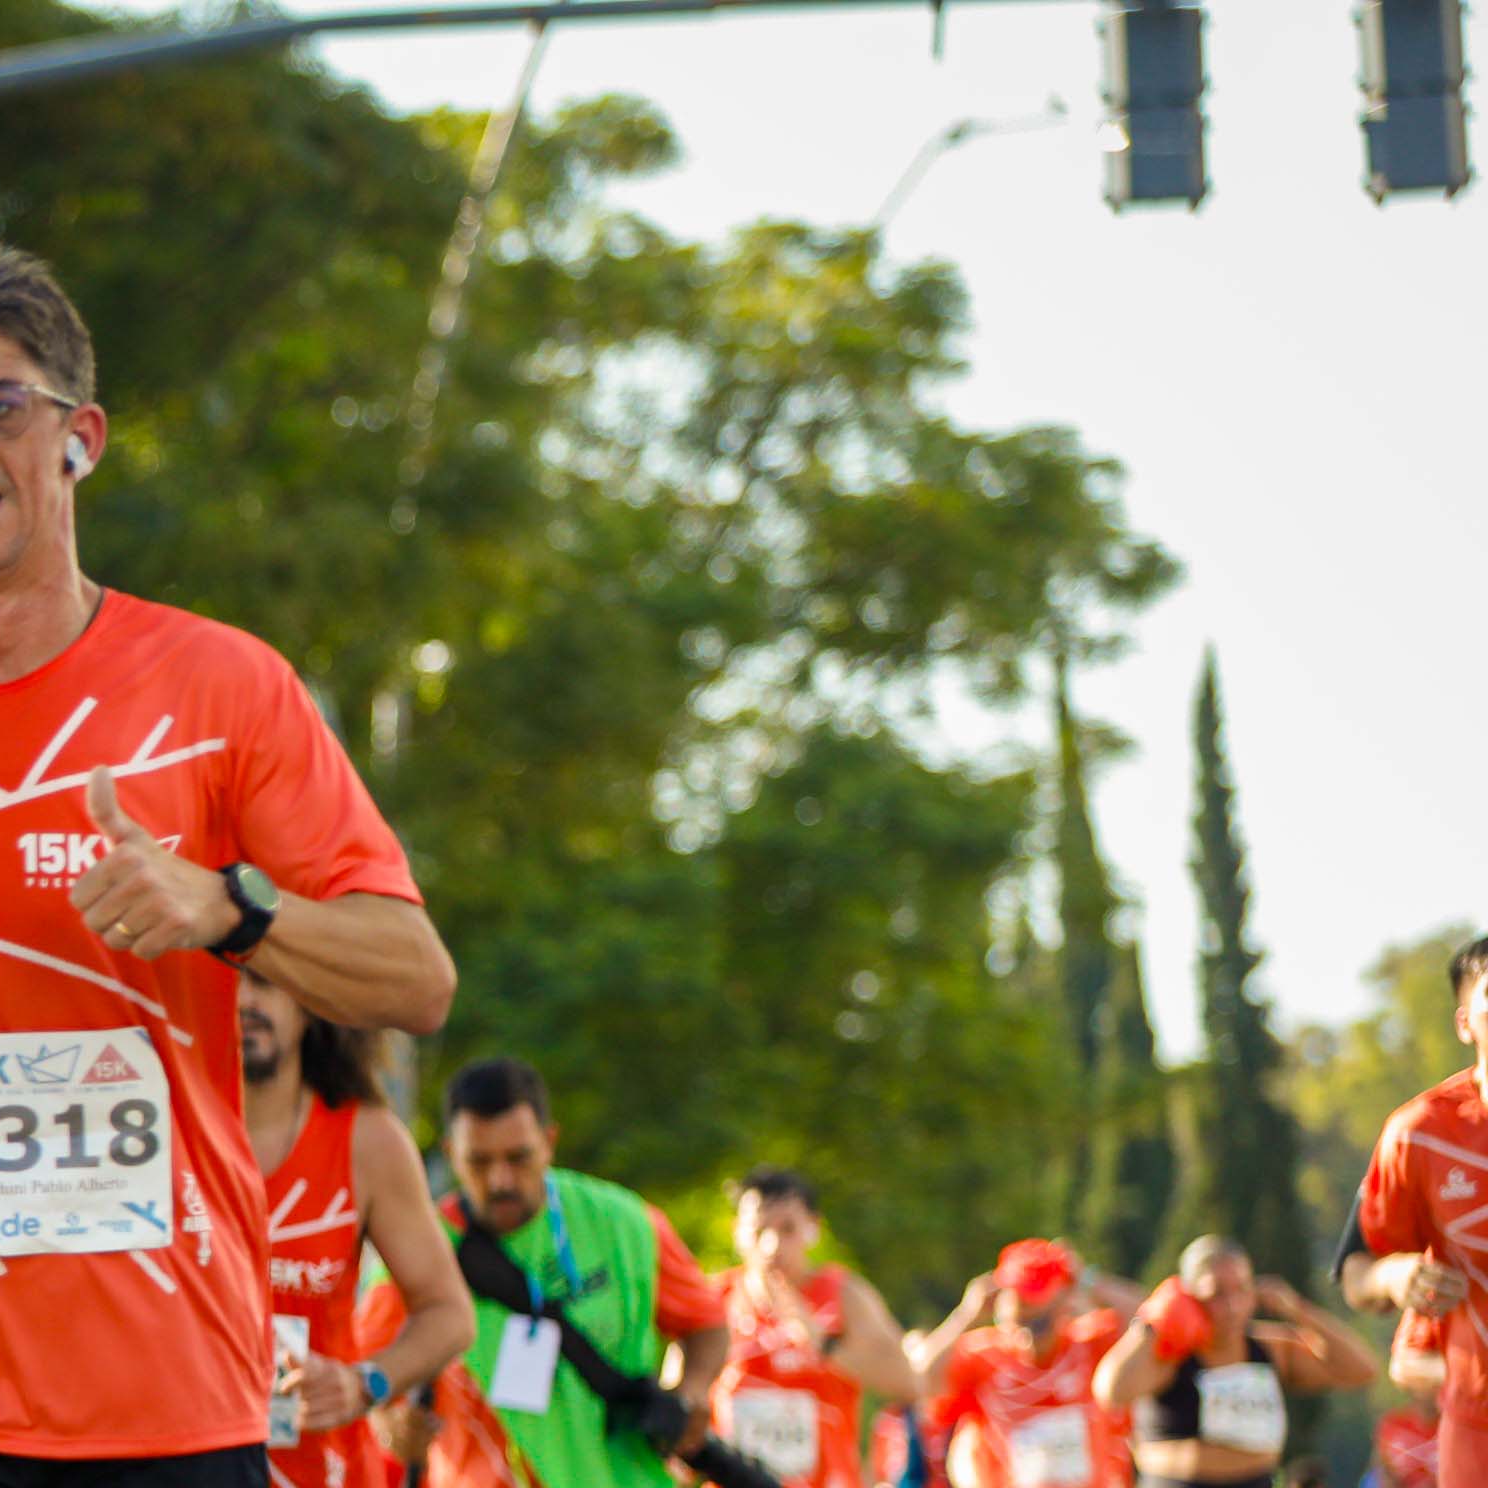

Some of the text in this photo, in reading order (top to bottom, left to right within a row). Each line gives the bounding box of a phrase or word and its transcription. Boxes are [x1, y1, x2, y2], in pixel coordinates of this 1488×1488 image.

[17, 832, 102, 874] 15K
[95, 1060, 129, 1078] 15K
[31, 1179, 72, 1194] Pablo
